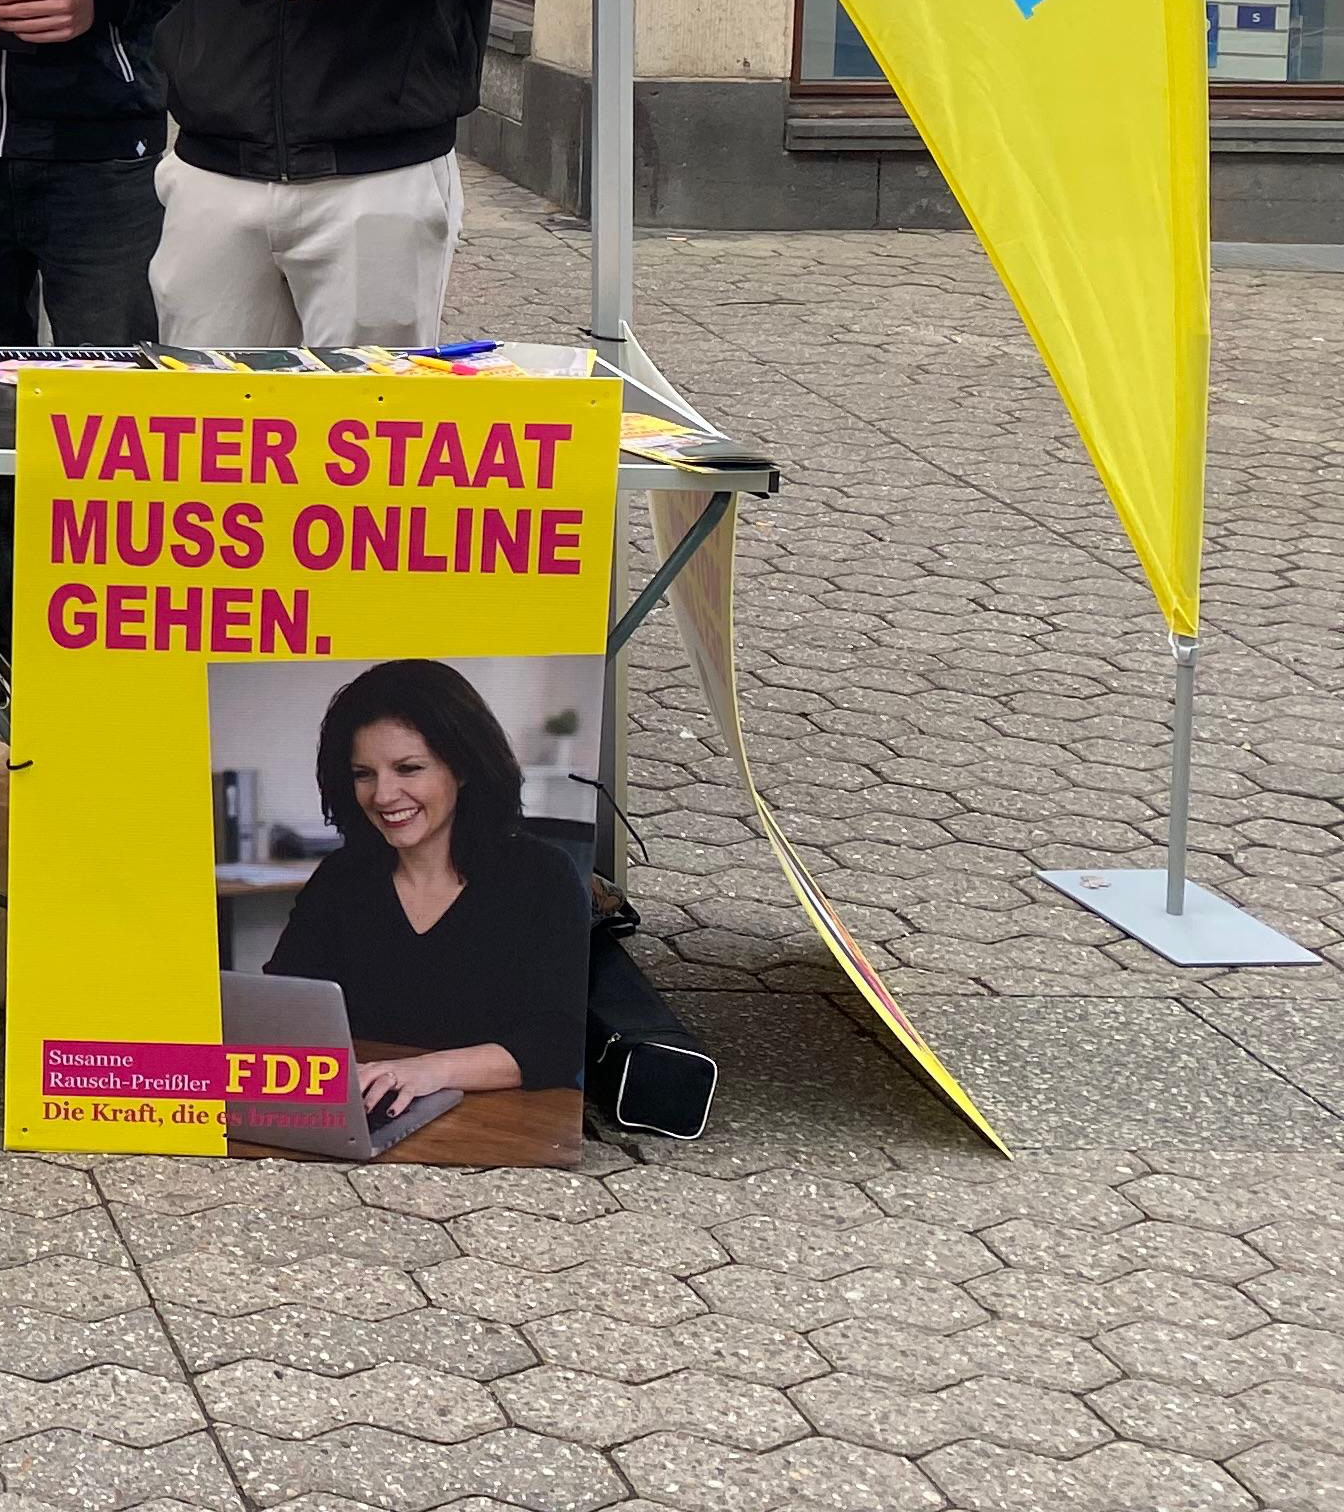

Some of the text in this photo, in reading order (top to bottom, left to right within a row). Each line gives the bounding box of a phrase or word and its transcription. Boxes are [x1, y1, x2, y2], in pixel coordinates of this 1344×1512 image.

[1252, 12, 1261, 23] S
[50, 414, 572, 489] VATER STAAT
[51, 499, 583, 575] MUSS ONLINE
[47, 583, 332, 655] GEHEN.
[49, 1049, 133, 1067] Susanne
[225, 1052, 340, 1096] FDP
[49, 1071, 211, 1092] Rausch-Preißler
[42, 1101, 84, 1122] Die
[91, 1102, 164, 1127] Kraft,
[171, 1103, 209, 1124] die
[216, 1111, 242, 1125] es
